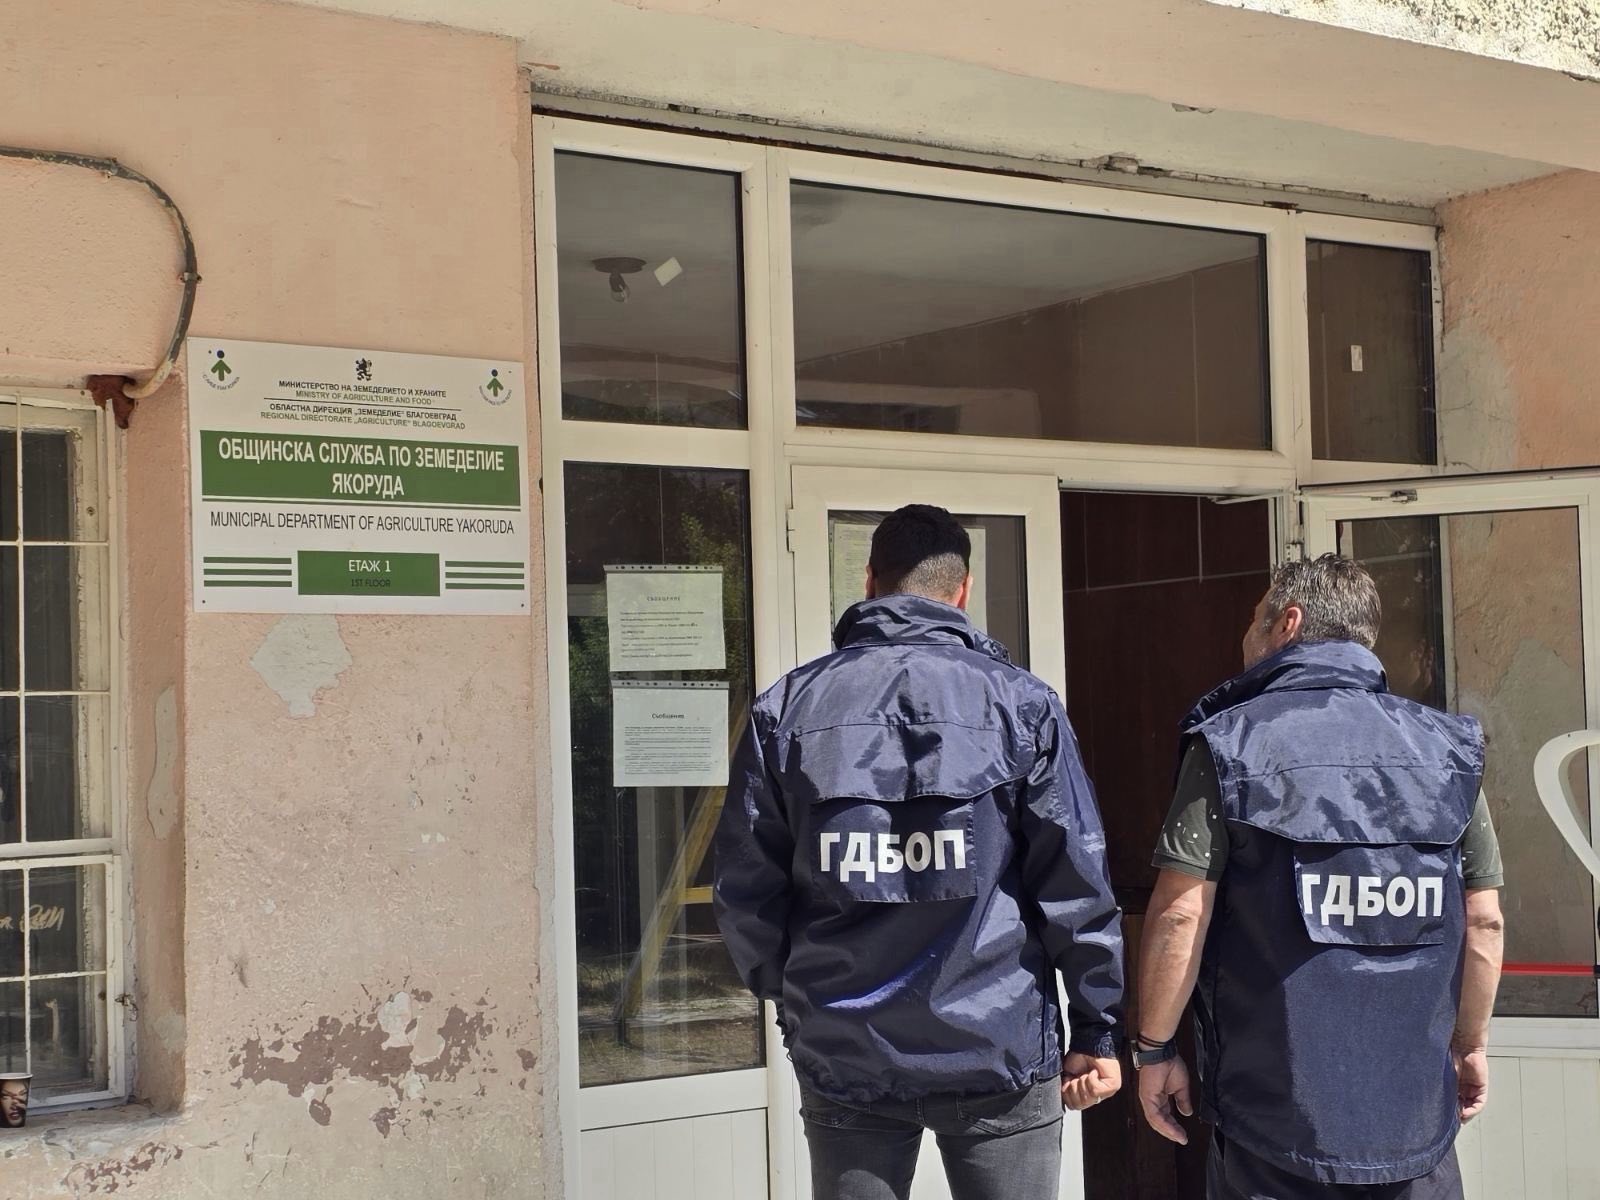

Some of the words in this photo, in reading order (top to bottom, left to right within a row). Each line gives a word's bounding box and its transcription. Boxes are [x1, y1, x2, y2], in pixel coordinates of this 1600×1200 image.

[279, 380, 339, 391] МИНИСТЕРСТВО
[354, 385, 407, 395] ЗЕМЕДЕЛИЕТО
[414, 389, 447, 398] ХРАНИТЕ
[296, 390, 330, 399] MINISTRY
[343, 393, 394, 403] AGRICULTURE
[260, 411, 299, 421] REGIONAL
[301, 414, 352, 423] DIRECTORATE
[412, 421, 466, 430] BLAGOEVGRAD
[270, 403, 311, 413] ОБЛАСТНА
[312, 405, 353, 415] ДИРЕКЦИЯ
[406, 411, 457, 421] БЛАГОЕВГРАД
[218, 437, 315, 464] ОБЩИНСКА
[319, 442, 386, 466] СЛУЖБА
[389, 445, 412, 467] ПО
[415, 447, 505, 473] ЗЕМЕДЕЛИЕ
[332, 472, 405, 499] ЯКОРУДА
[210, 511, 275, 527] MUNICIPAL
[277, 512, 356, 530] DEPARTMENT
[358, 515, 374, 531] OF
[376, 515, 454, 533] AGRICULTURE
[456, 518, 515, 534] YAKORUDA
[348, 559, 381, 573] ЕТАЖ
[385, 560, 392, 573] 1
[365, 579, 391, 588] FLOOR
[820, 829, 966, 883] ГДБОП
[1301, 873, 1443, 927] ГДБОП
